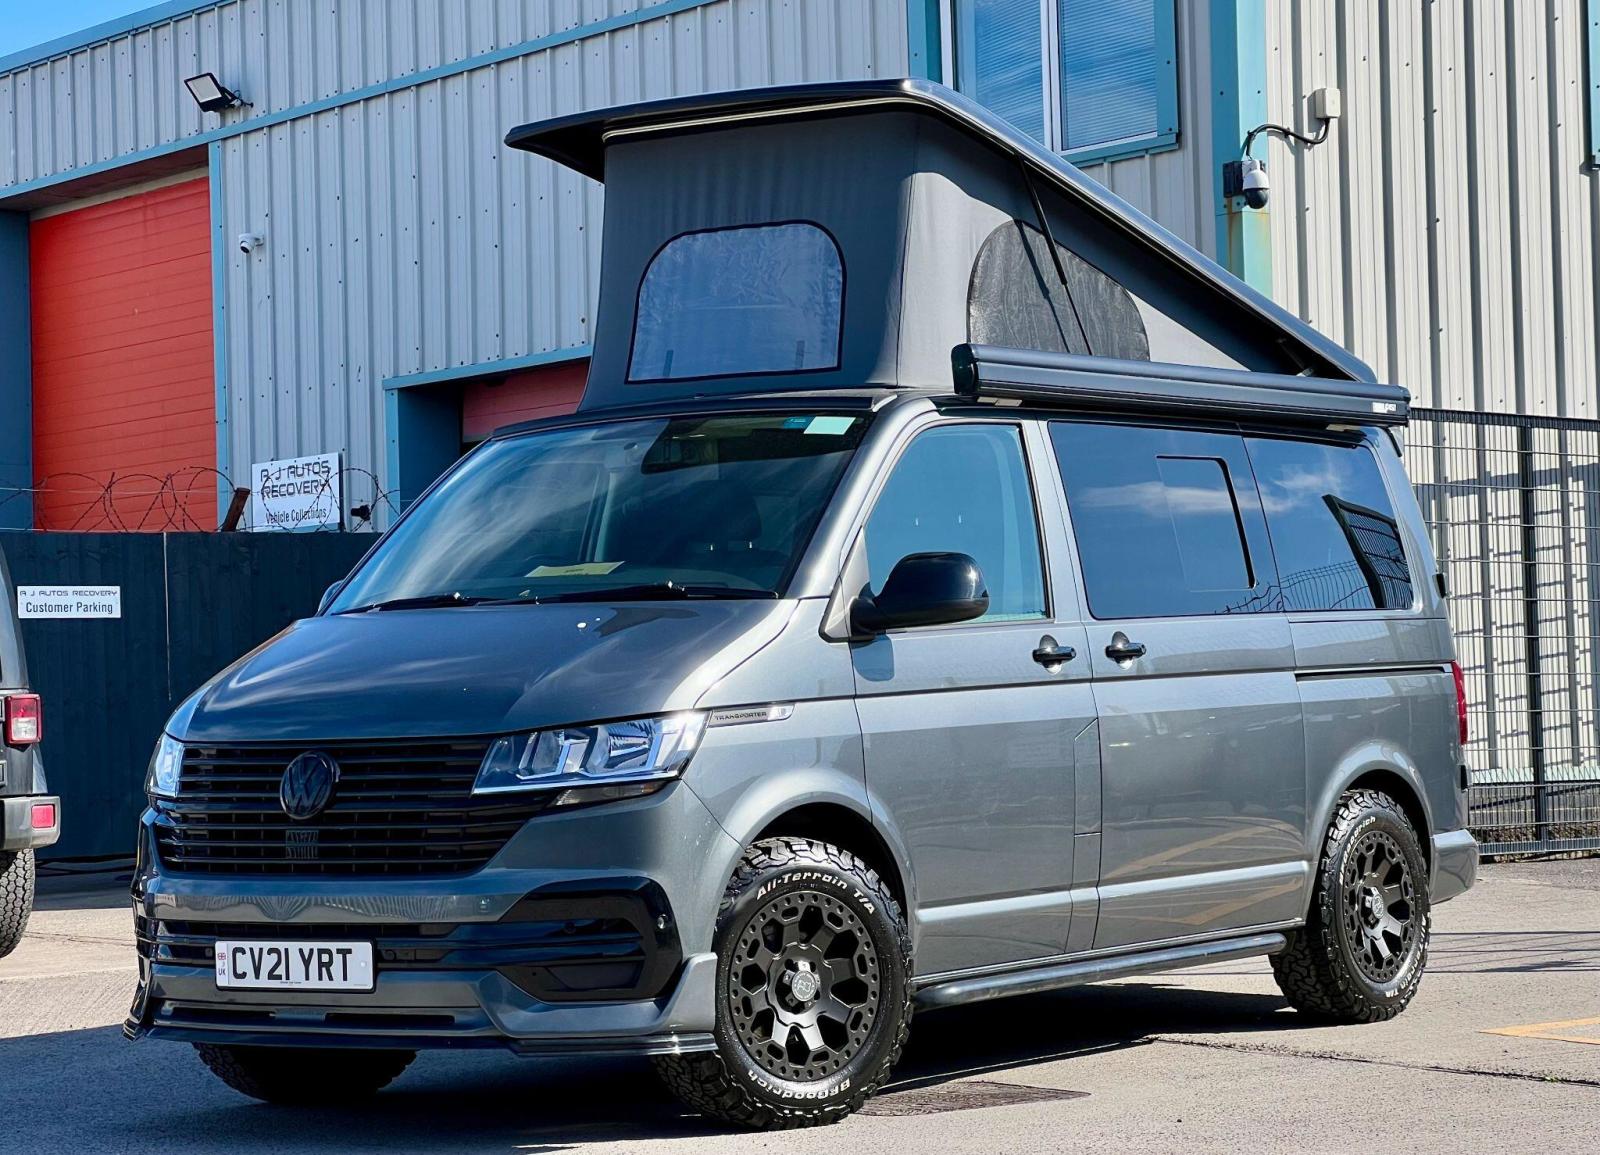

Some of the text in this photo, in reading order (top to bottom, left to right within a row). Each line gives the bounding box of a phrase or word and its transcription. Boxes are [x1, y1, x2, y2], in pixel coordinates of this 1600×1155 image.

[274, 466, 282, 481] J
[287, 460, 330, 480] AUTOS
[262, 479, 328, 499] RECOVERY
[265, 508, 327, 525] Vehicle Collections
[26, 602, 113, 615] Customer Parking
[714, 711, 767, 721] TRANSPORTER
[756, 870, 876, 915] All-Terrain T/A
[218, 968, 226, 976] UK
[232, 946, 353, 982] CV21 YRT
[748, 1070, 851, 1100] BFGoodrich
